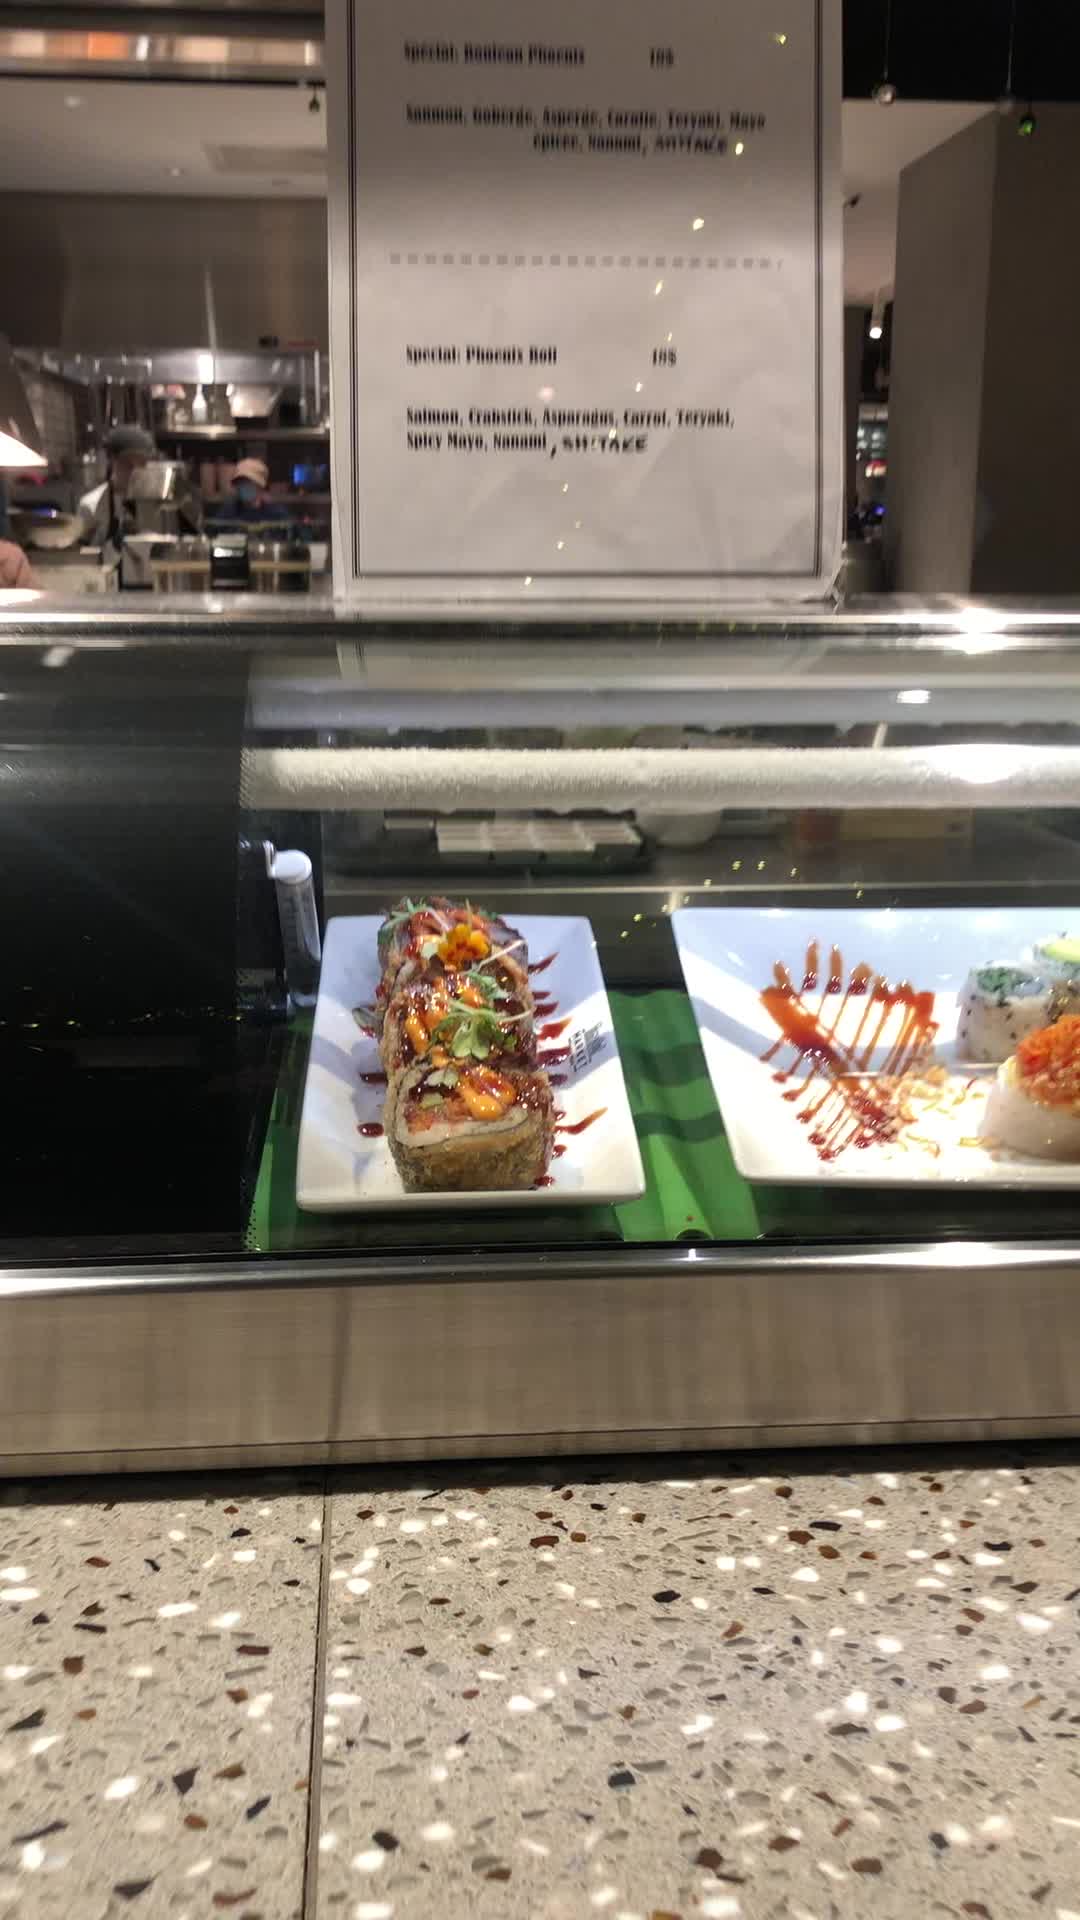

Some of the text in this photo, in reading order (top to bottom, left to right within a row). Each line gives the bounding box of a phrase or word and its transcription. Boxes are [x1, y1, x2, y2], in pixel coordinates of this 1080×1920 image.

[528, 43, 585, 69] Phoenix
[730, 110, 766, 132] Mayo
[406, 345, 460, 368] Special:
[465, 345, 523, 367] Phoenix
[528, 345, 557, 366] Roll
[407, 406, 463, 427] Salmon,
[469, 406, 537, 427] Crabstick,
[543, 406, 619, 428] Asparagus,
[624, 407, 671, 428] Carrot,
[407, 431, 441, 450] Spicy
[447, 431, 487, 451] Mayo,
